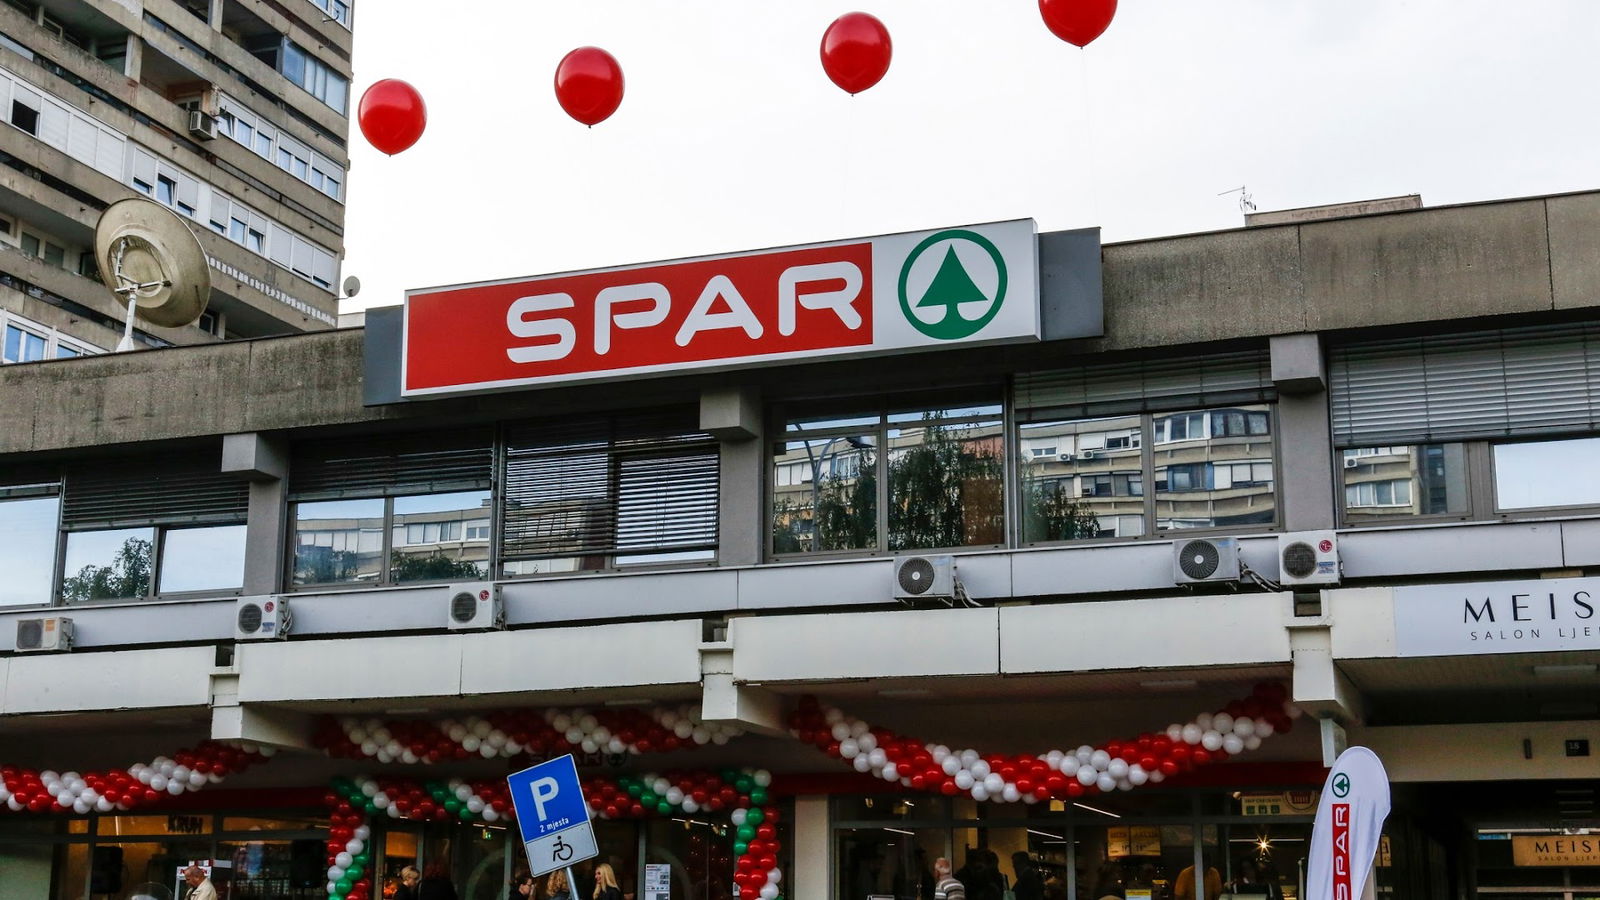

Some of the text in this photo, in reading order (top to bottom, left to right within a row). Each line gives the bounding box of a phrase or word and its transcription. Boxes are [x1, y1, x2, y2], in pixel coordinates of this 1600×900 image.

[506, 261, 863, 363] SPAR
[1464, 591, 1594, 623] MEIS
[1470, 627, 1600, 640] SALON LJE
[530, 777, 559, 822] P
[539, 817, 569, 833] 2 mjesta
[1335, 806, 1348, 900] SPAR
[1535, 839, 1600, 853] MEIS
